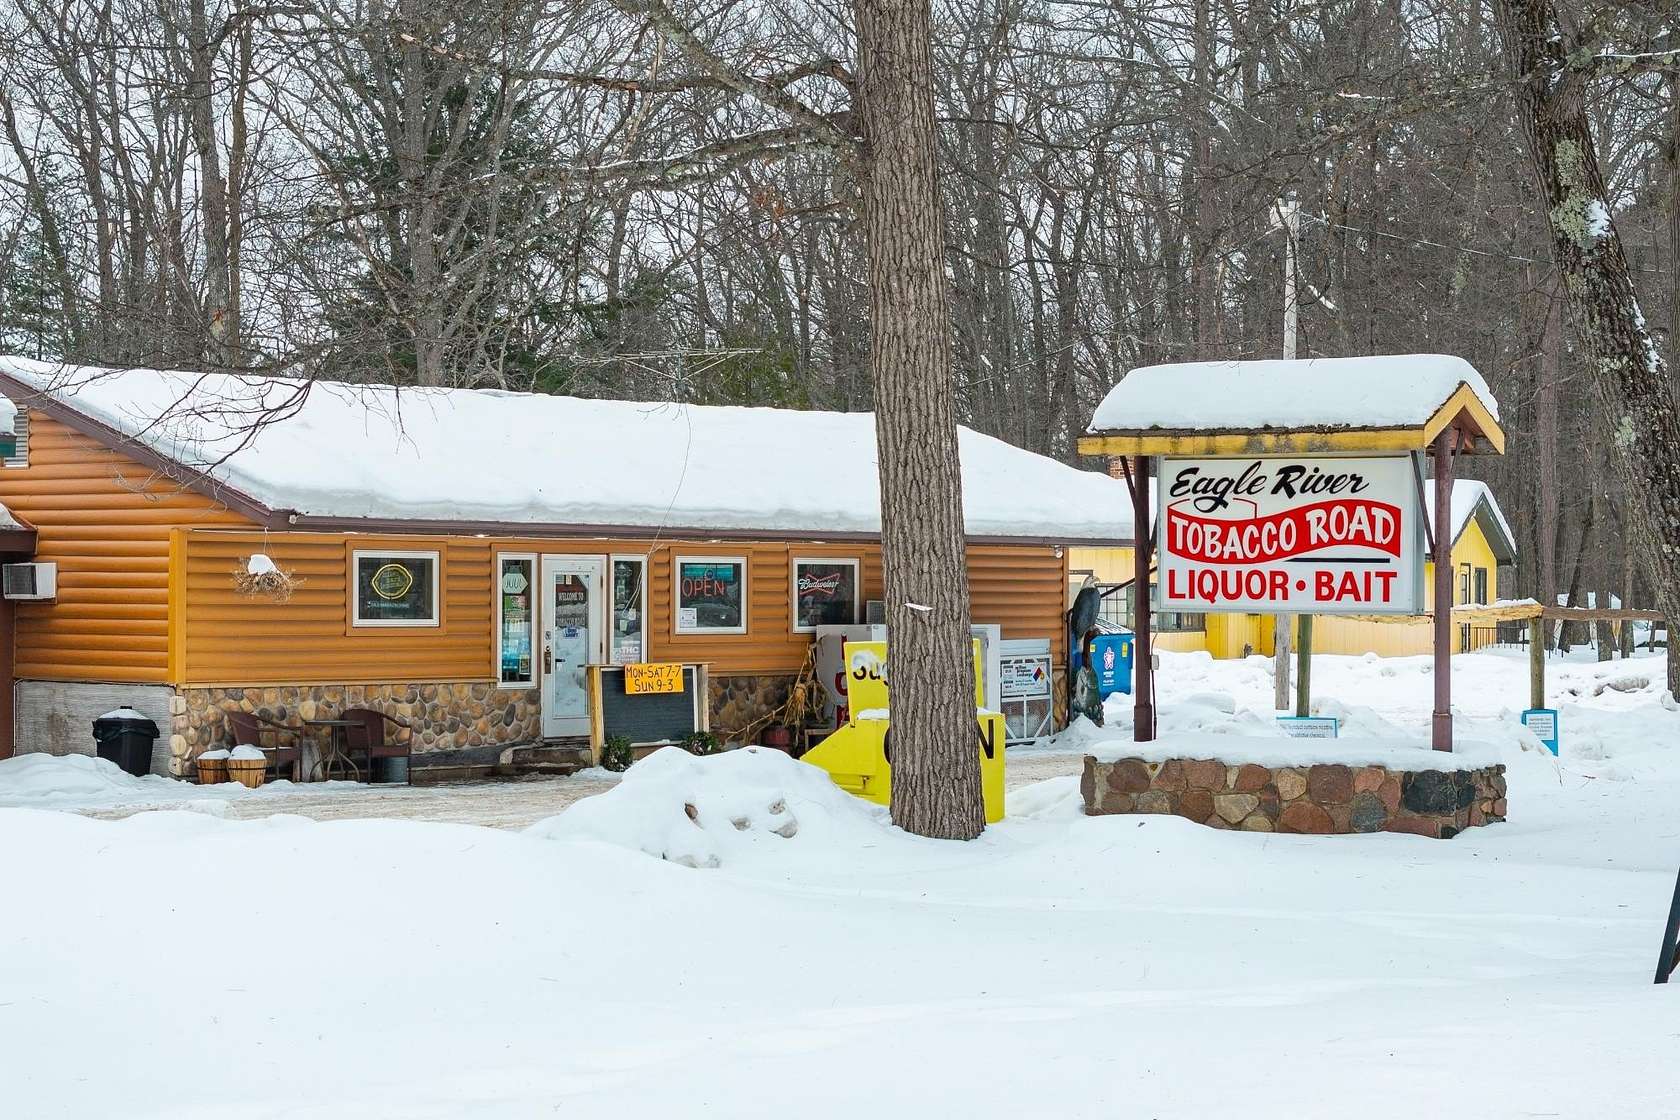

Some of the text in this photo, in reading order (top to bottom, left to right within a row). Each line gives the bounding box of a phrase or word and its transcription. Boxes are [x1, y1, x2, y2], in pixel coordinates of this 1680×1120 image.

[1170, 460, 1370, 513] Eagle River
[1171, 505, 1395, 560] TOBACCO ROAD
[682, 578, 725, 597] OPEN
[798, 577, 839, 590] Budweiser
[1168, 569, 1398, 604] LIQUOR BAIT
[558, 592, 577, 601] WELCOME
[666, 665, 681, 677] 7-7
[634, 679, 673, 692] SUN 9-3
